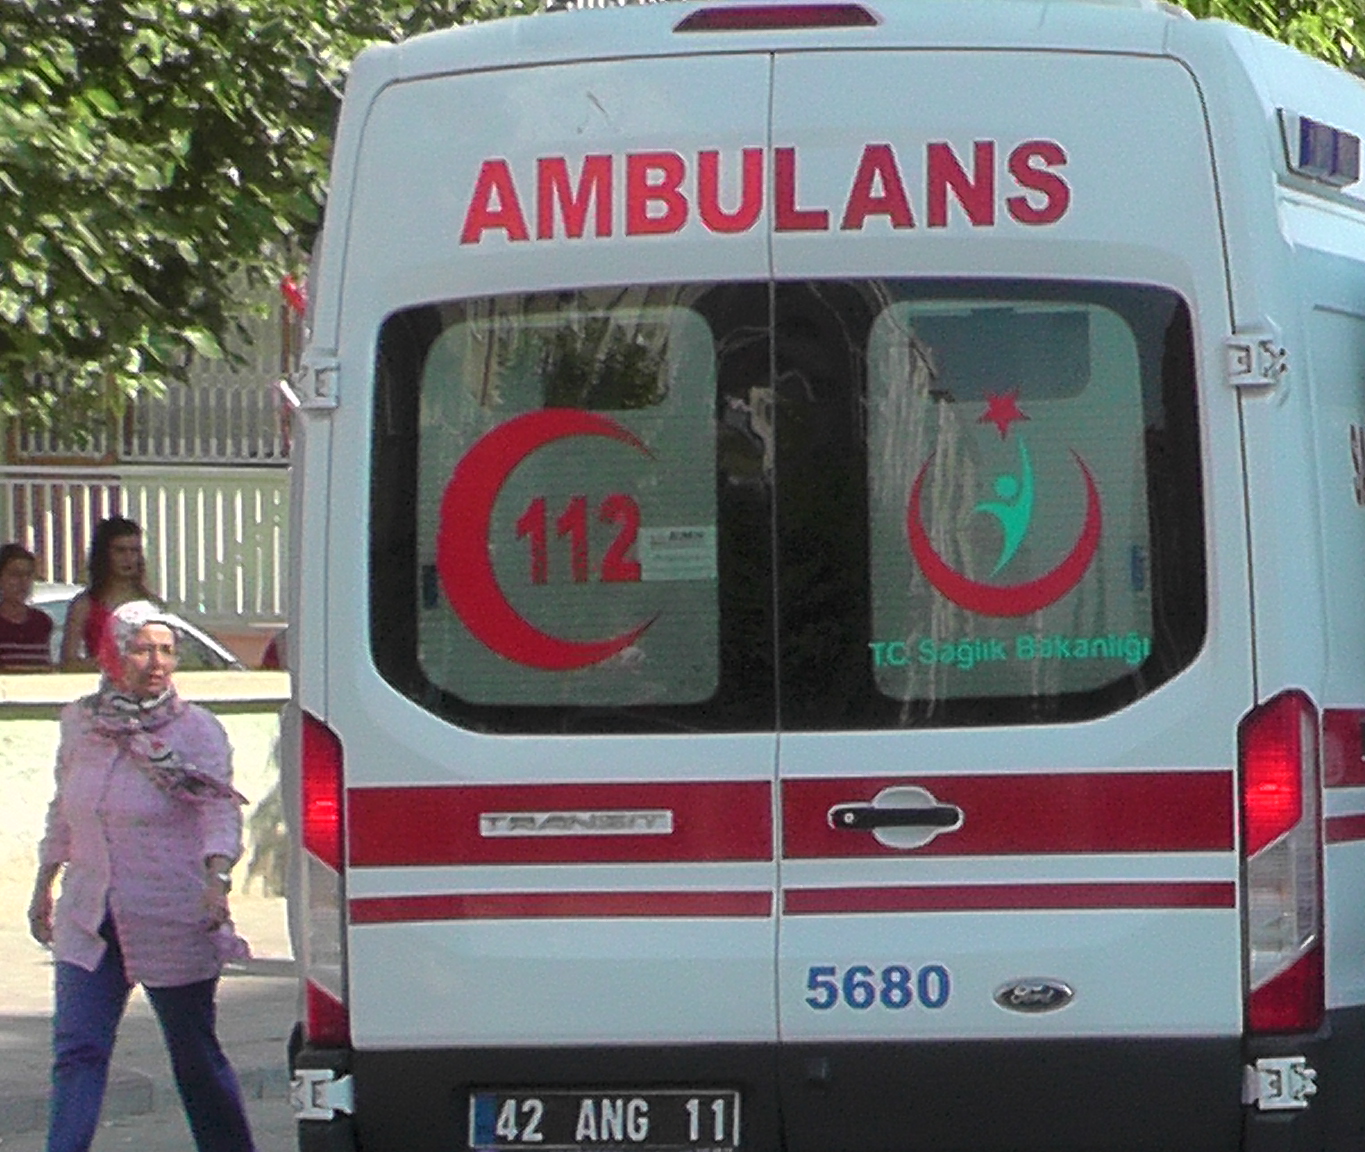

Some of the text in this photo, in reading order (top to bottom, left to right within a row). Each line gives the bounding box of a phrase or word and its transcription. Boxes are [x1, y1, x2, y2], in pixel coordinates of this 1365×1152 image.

[460, 140, 1071, 246] AMBULANS
[515, 493, 642, 585] 112
[1016, 632, 1151, 664] Bakanlığı
[805, 964, 951, 1010] 5680
[496, 1098, 725, 1142] 42 ANG 11
